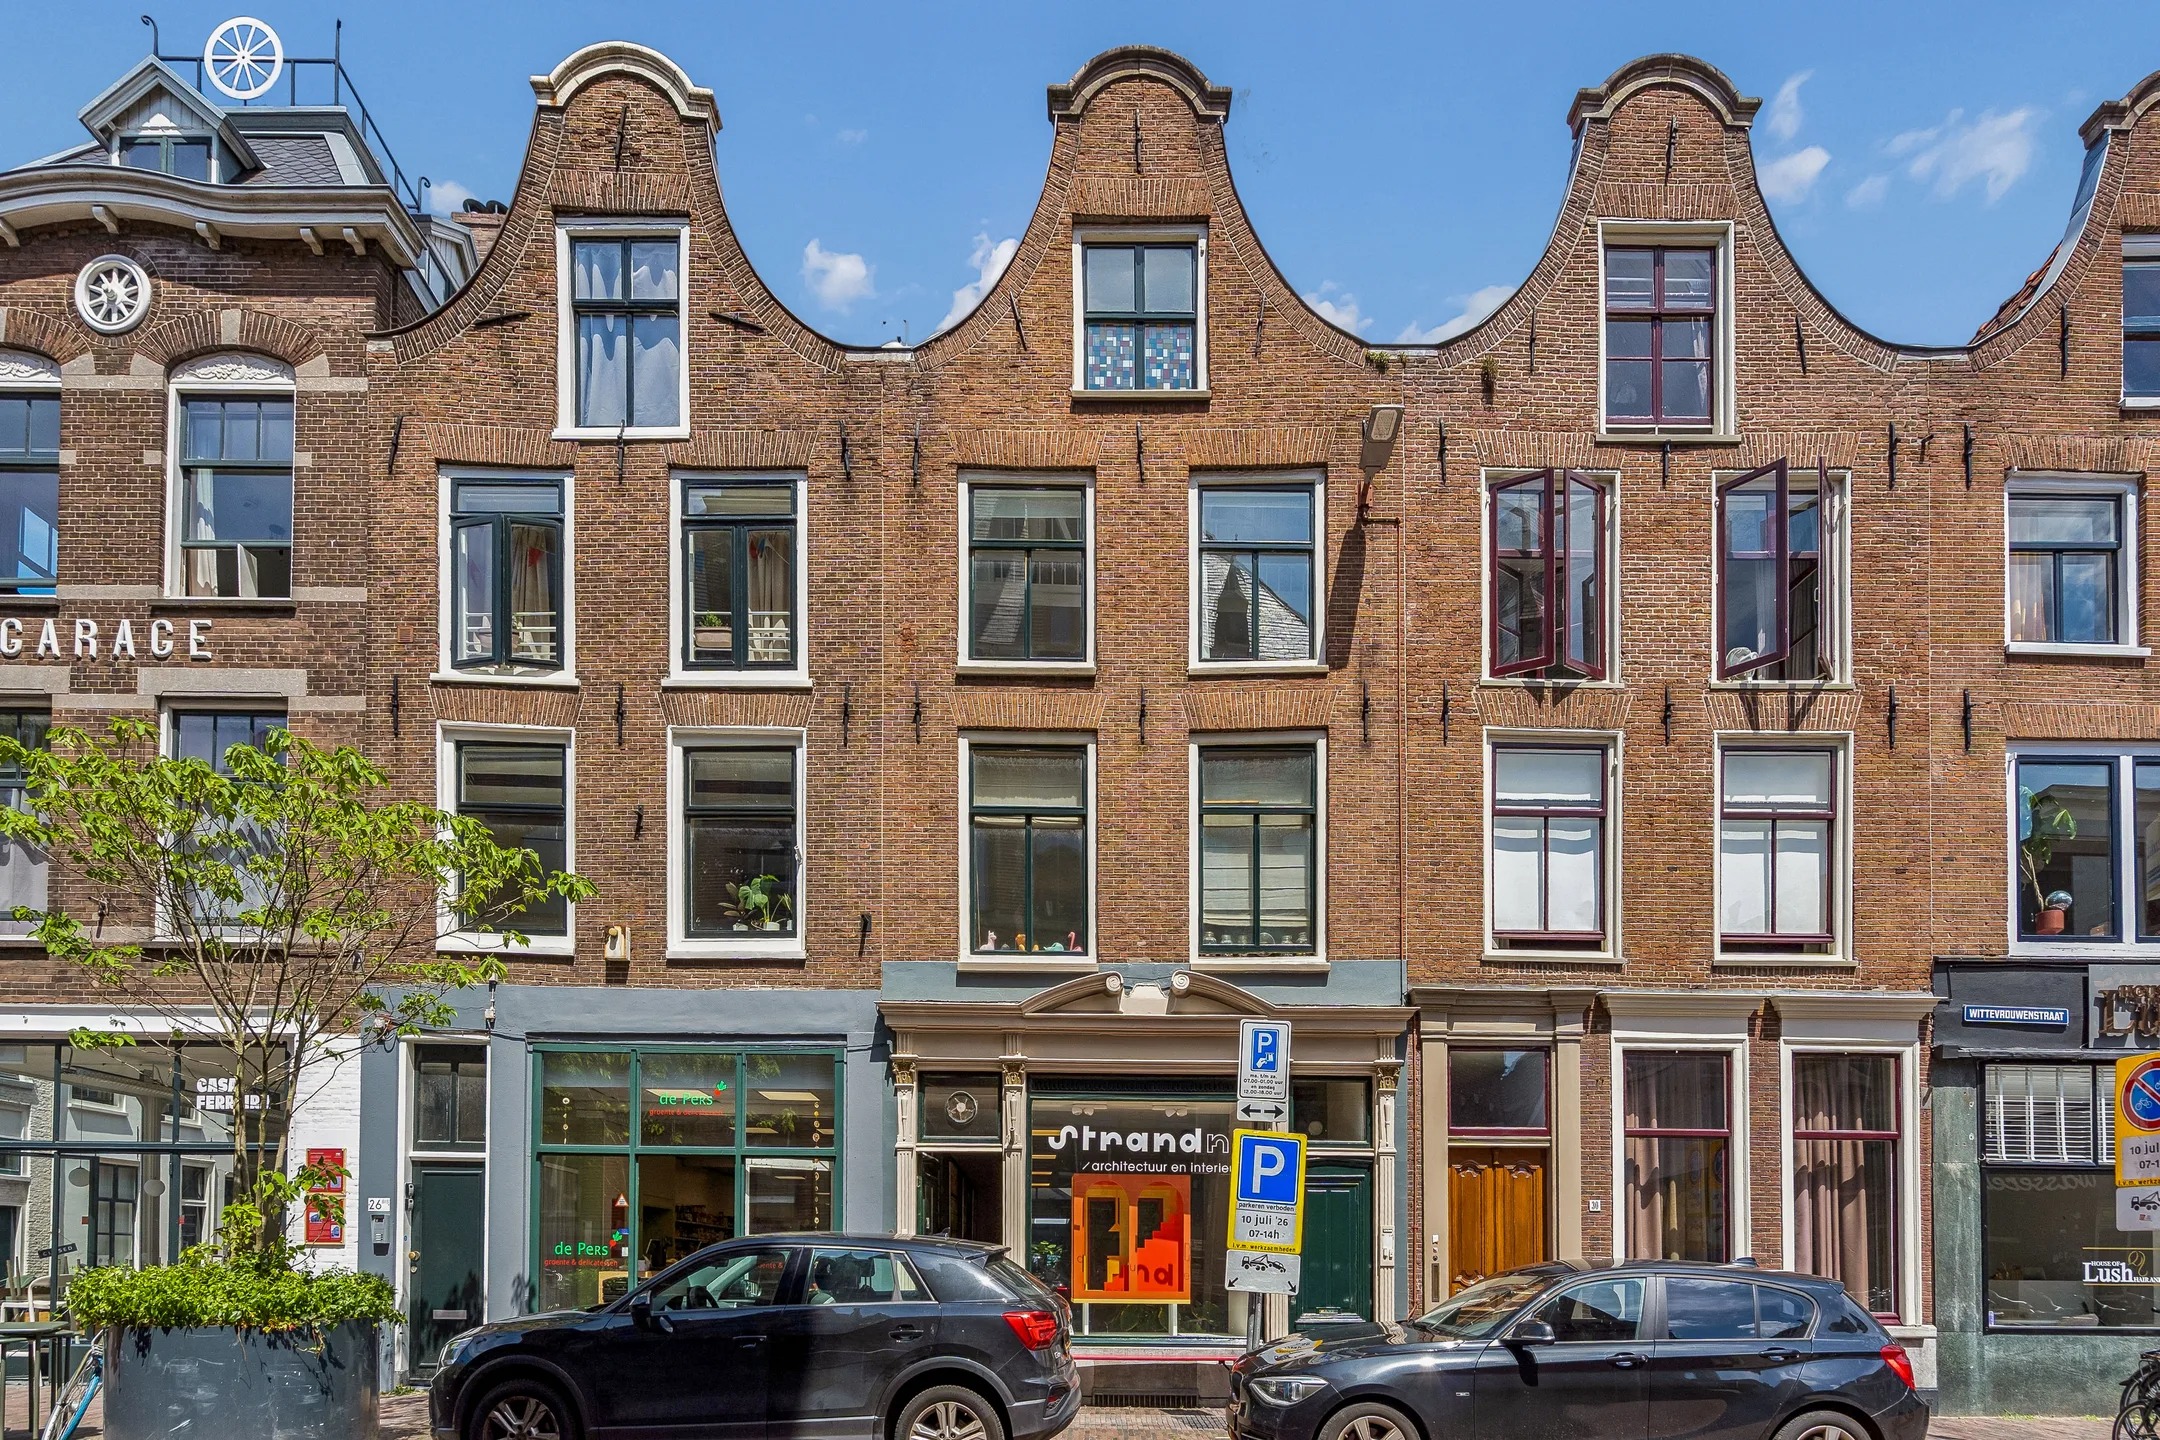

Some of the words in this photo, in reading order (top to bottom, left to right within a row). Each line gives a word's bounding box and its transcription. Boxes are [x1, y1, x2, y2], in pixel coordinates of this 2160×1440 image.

[0, 618, 212, 660] GARAGE
[1969, 1008, 2064, 1020] WITTEVROUWENSTRAAT
[1257, 1032, 1272, 1053] P
[659, 1092, 677, 1105] de
[2130, 1146, 2141, 1155] 10
[2144, 1141, 2160, 1155] jul
[1172, 1162, 1187, 1173] en
[1190, 1161, 1231, 1173] interie
[1252, 1145, 1286, 1194] P
[2139, 1160, 2160, 1169] 07-1
[369, 1200, 382, 1209] 26
[1238, 1202, 1265, 1210] parkeren
[1241, 1215, 1252, 1224] 10
[1254, 1214, 1272, 1226] juli
[1249, 1229, 1279, 1239] 07-14h
[42, 1245, 73, 1257] CSED
[554, 1241, 572, 1255] de
[544, 1259, 570, 1267] groente
[2082, 1262, 2133, 1283] Lush
